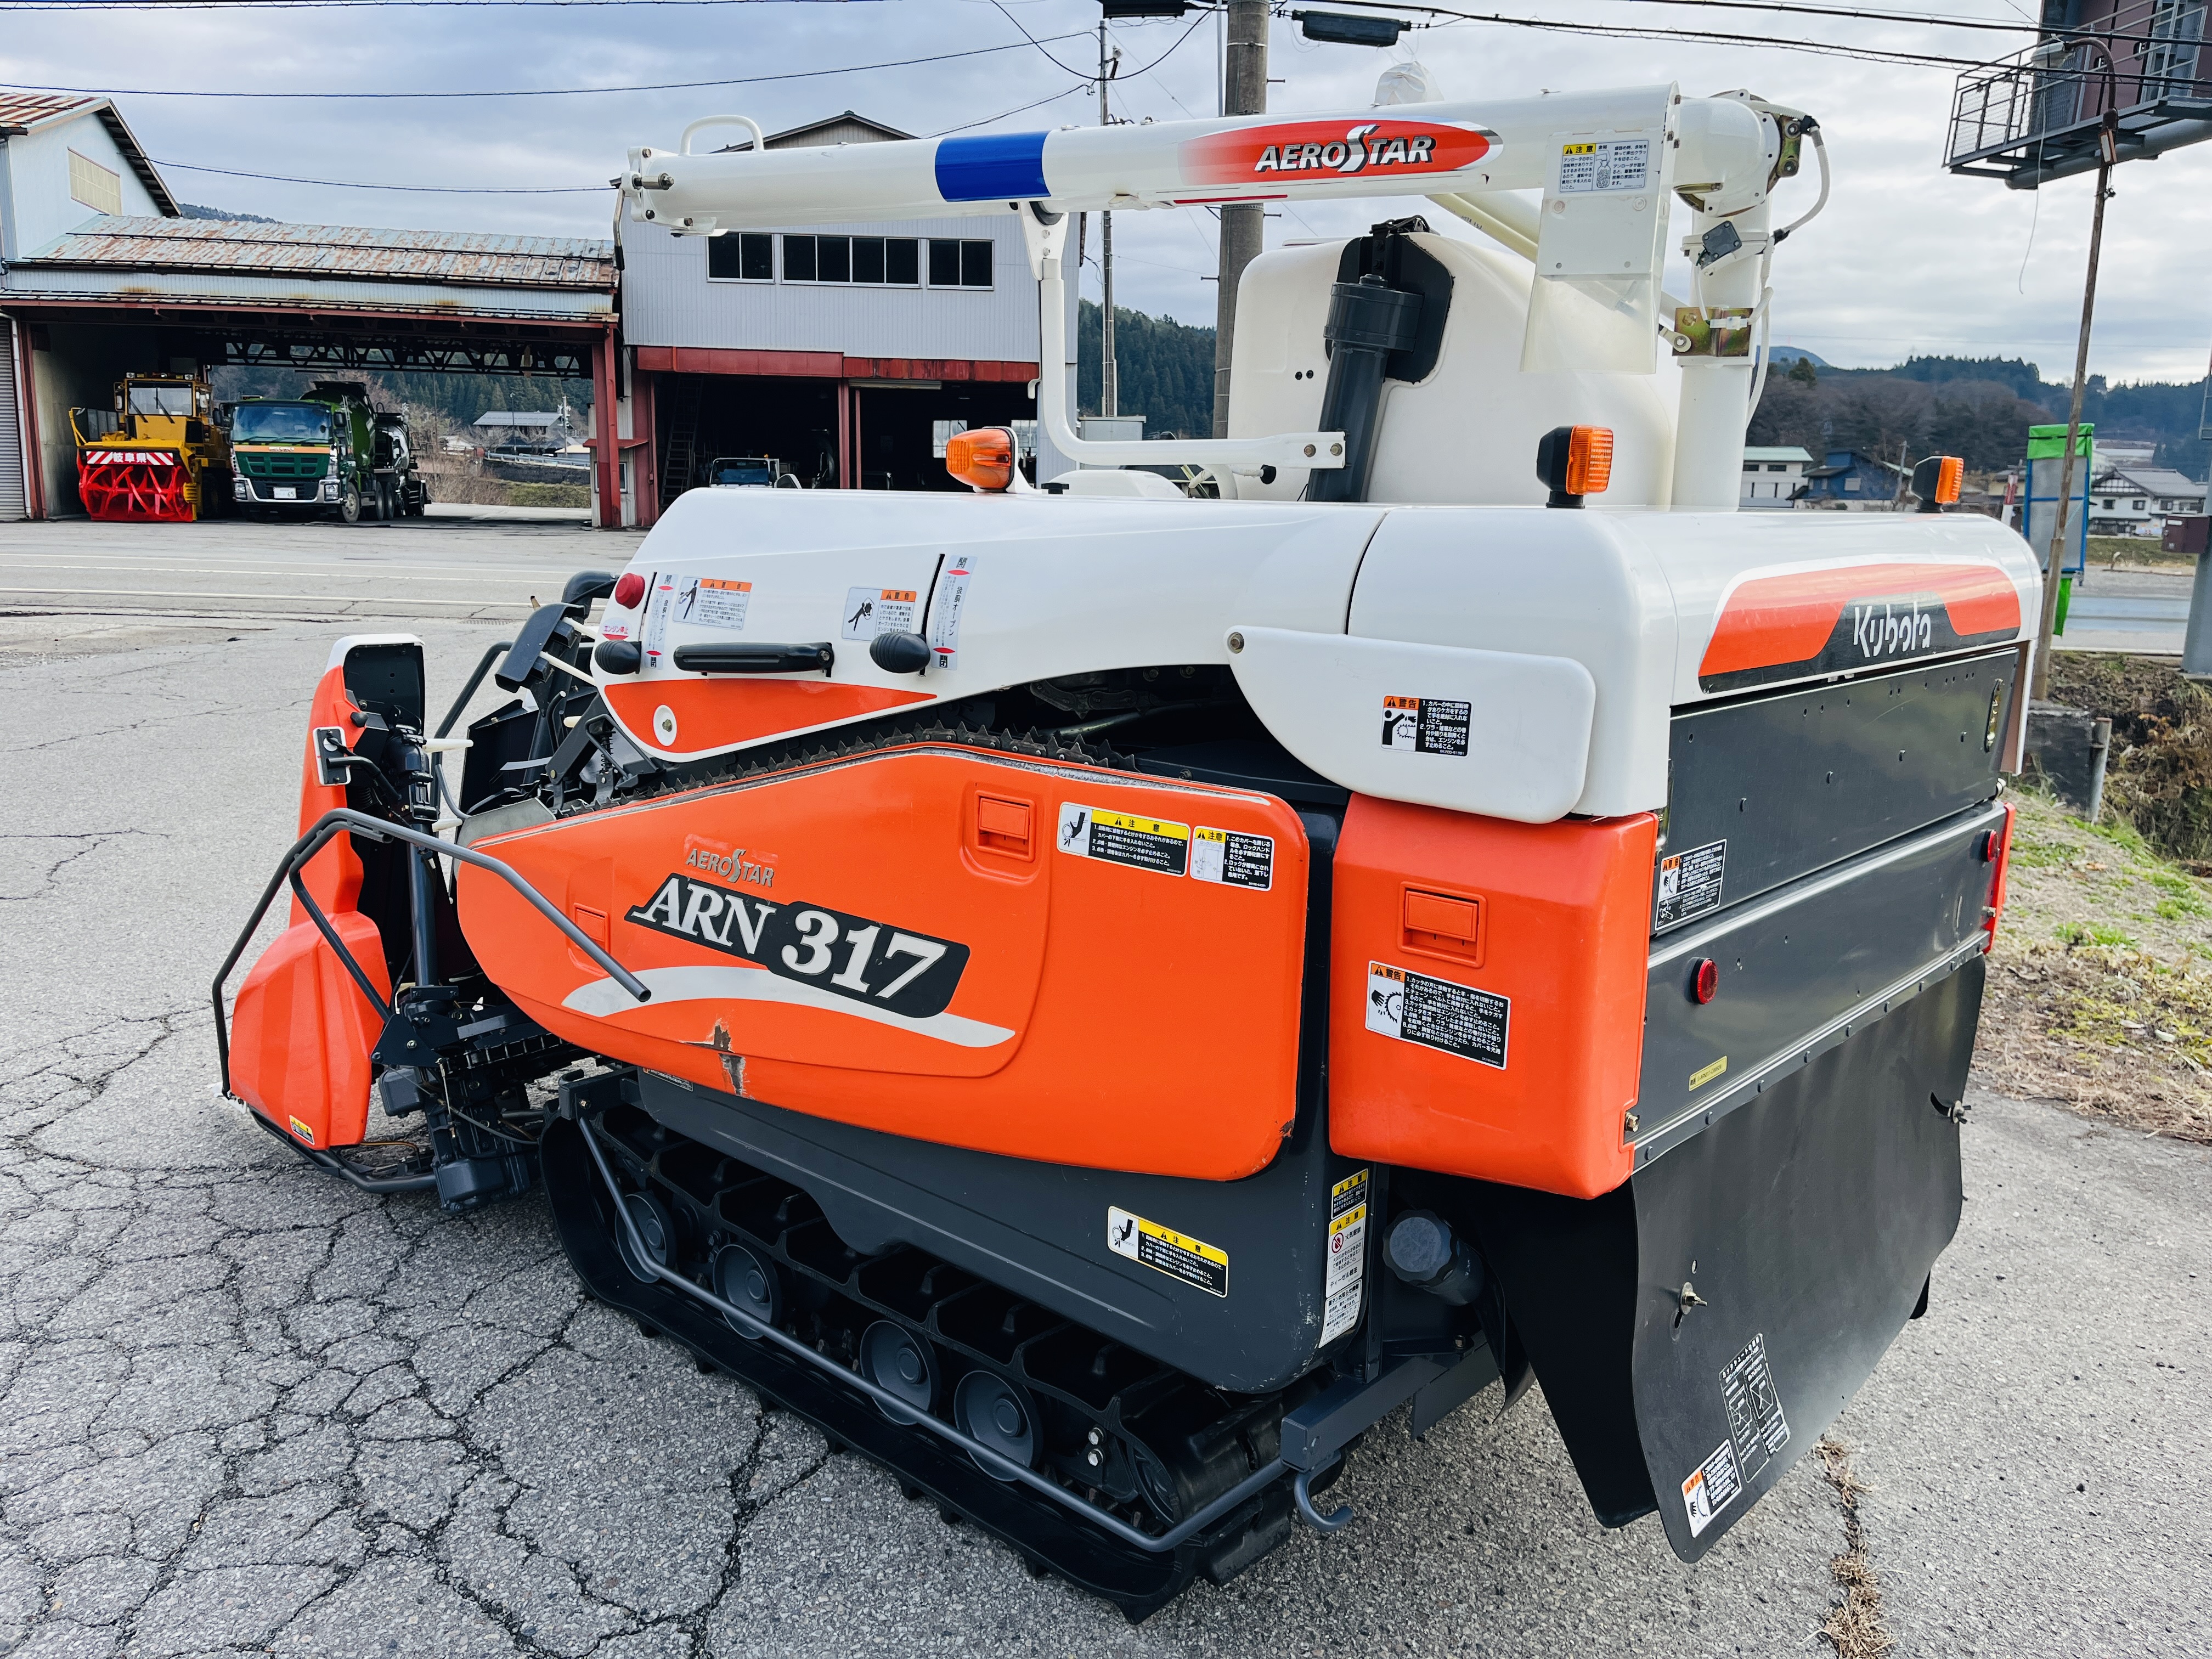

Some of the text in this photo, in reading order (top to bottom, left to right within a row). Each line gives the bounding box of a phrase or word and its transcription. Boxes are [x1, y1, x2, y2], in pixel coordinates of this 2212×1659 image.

[1254, 124, 1436, 173] AEROSTAR
[1576, 145, 1593, 153] 注意
[1853, 602, 1931, 658] Kubota
[1399, 698, 1416, 708] 警告
[1128, 819, 1160, 832] 注意
[1208, 831, 1222, 841] 注意
[685, 848, 775, 888] AEROSTAR
[631, 877, 949, 1000] ARN 317
[1386, 969, 1401, 980] 警告
[1172, 1235, 1201, 1253] 注意
